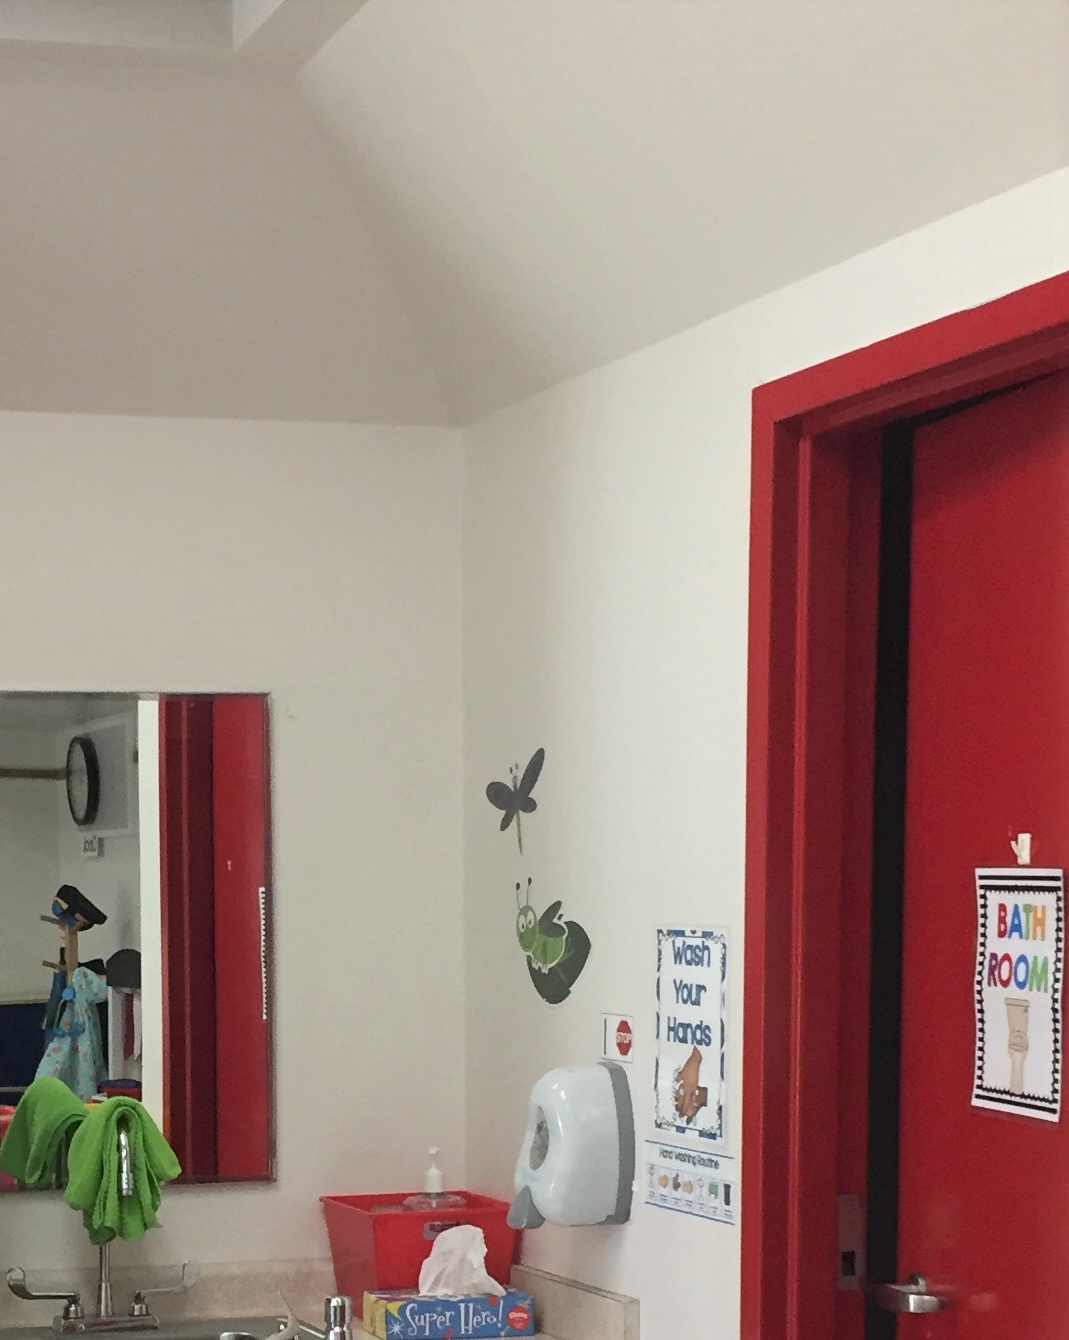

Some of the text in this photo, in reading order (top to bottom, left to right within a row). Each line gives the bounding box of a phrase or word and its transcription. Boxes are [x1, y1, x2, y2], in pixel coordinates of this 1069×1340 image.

[997, 903, 1046, 941] BATH
[672, 940, 711, 968] Wash
[987, 952, 1049, 993] ROOM
[673, 979, 707, 1006] Your
[667, 1016, 712, 1047] Hands
[405, 1299, 504, 1336] Super Hero!
